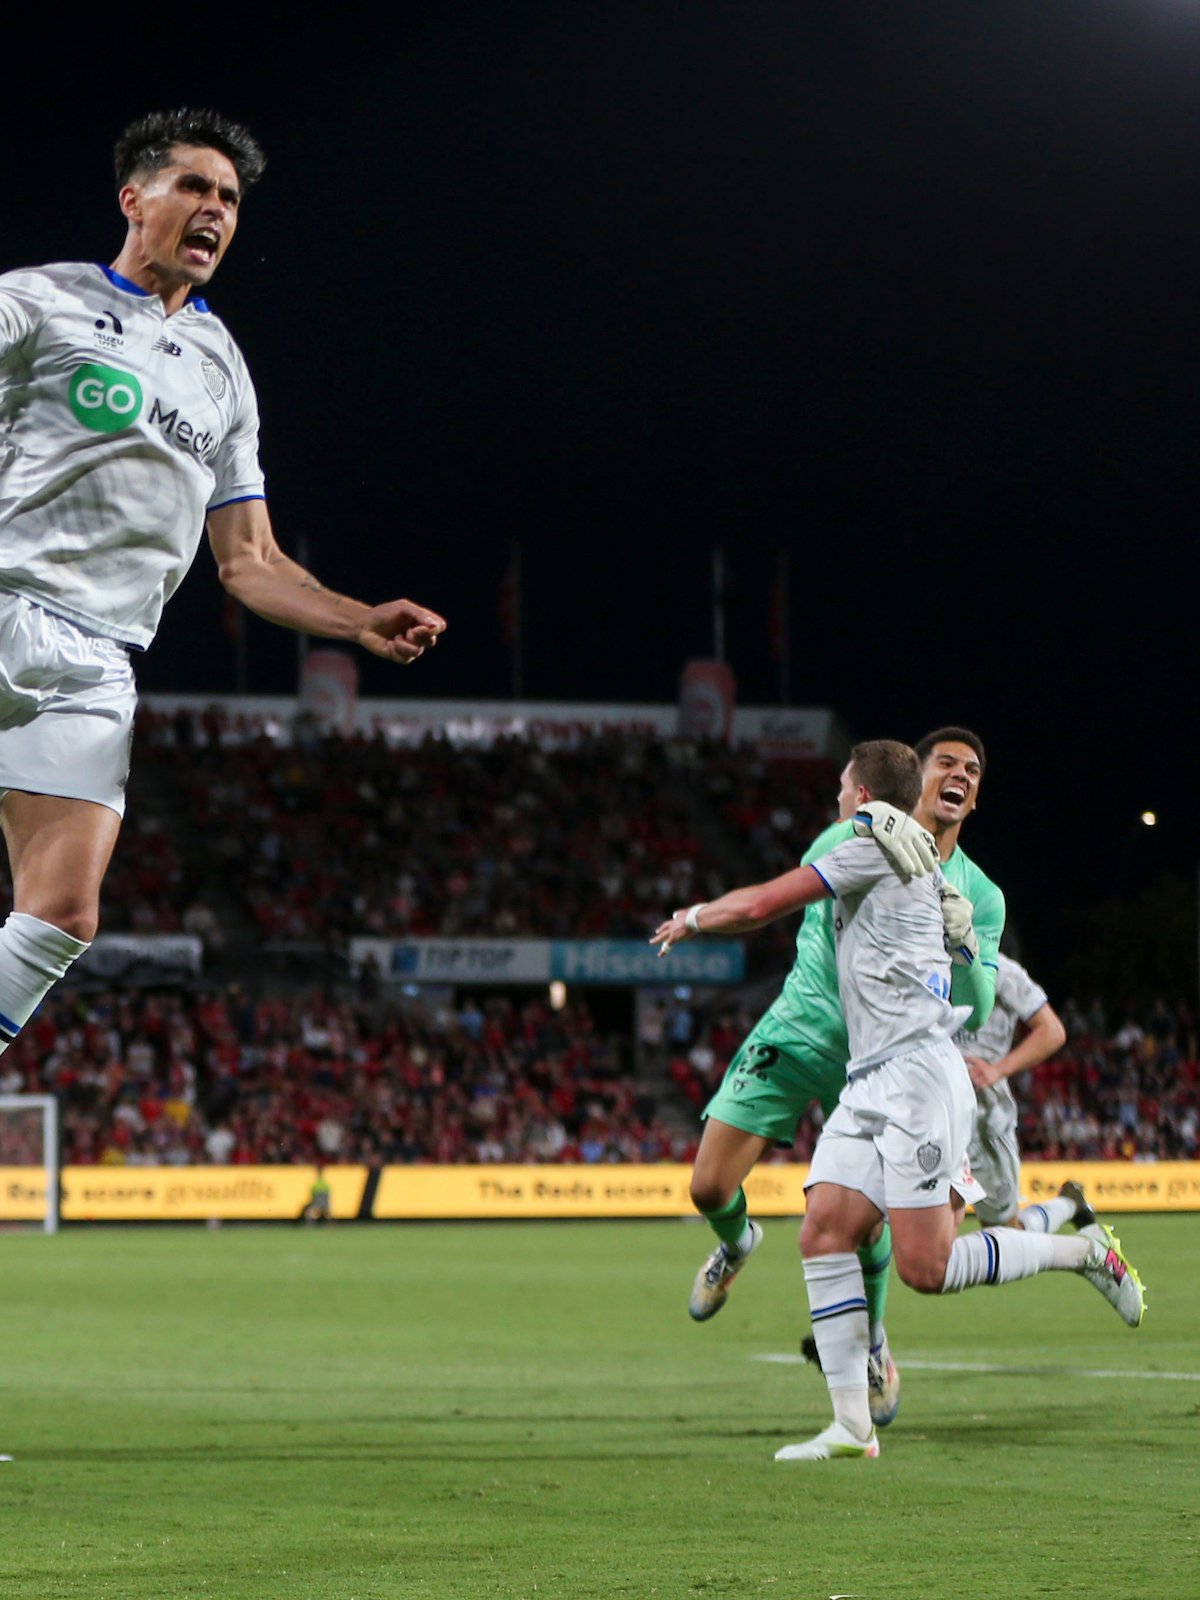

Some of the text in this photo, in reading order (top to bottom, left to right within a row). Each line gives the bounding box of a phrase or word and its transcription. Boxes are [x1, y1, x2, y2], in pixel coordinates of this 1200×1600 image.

[93, 332, 124, 345] ISUZU
[76, 378, 136, 414] GO
[566, 944, 731, 979] Hisense
[82, 1186, 155, 1202] score
[477, 1179, 522, 1200] The
[535, 1180, 593, 1200] Reds
[604, 1183, 672, 1201] score
[1095, 1180, 1159, 1197] score
